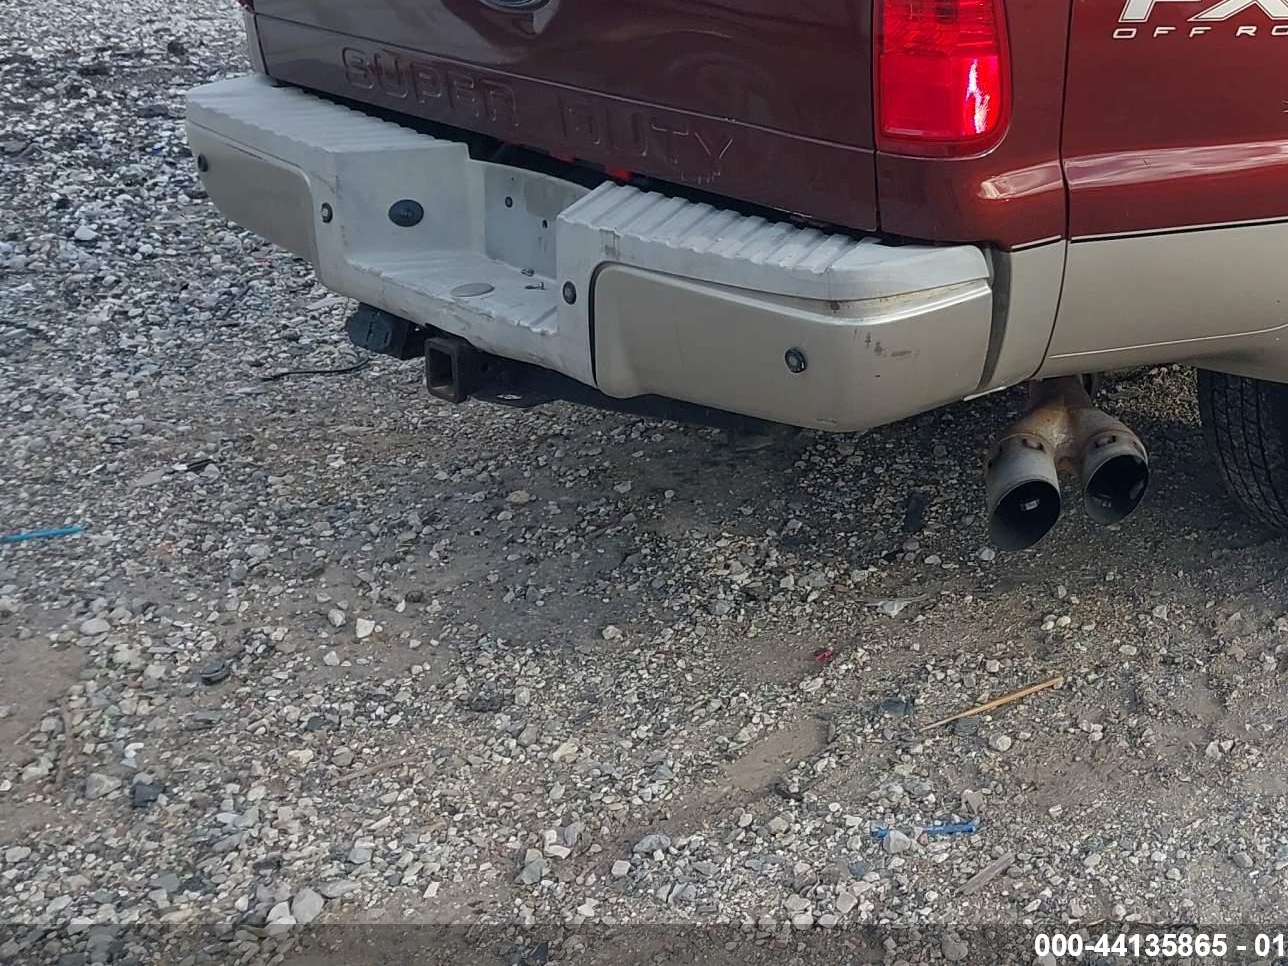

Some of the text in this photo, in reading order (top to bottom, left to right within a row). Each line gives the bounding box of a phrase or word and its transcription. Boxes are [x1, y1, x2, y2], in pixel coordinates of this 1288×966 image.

[1112, 26, 1212, 39] OFF
[341, 45, 735, 185] SUPER DUTY
